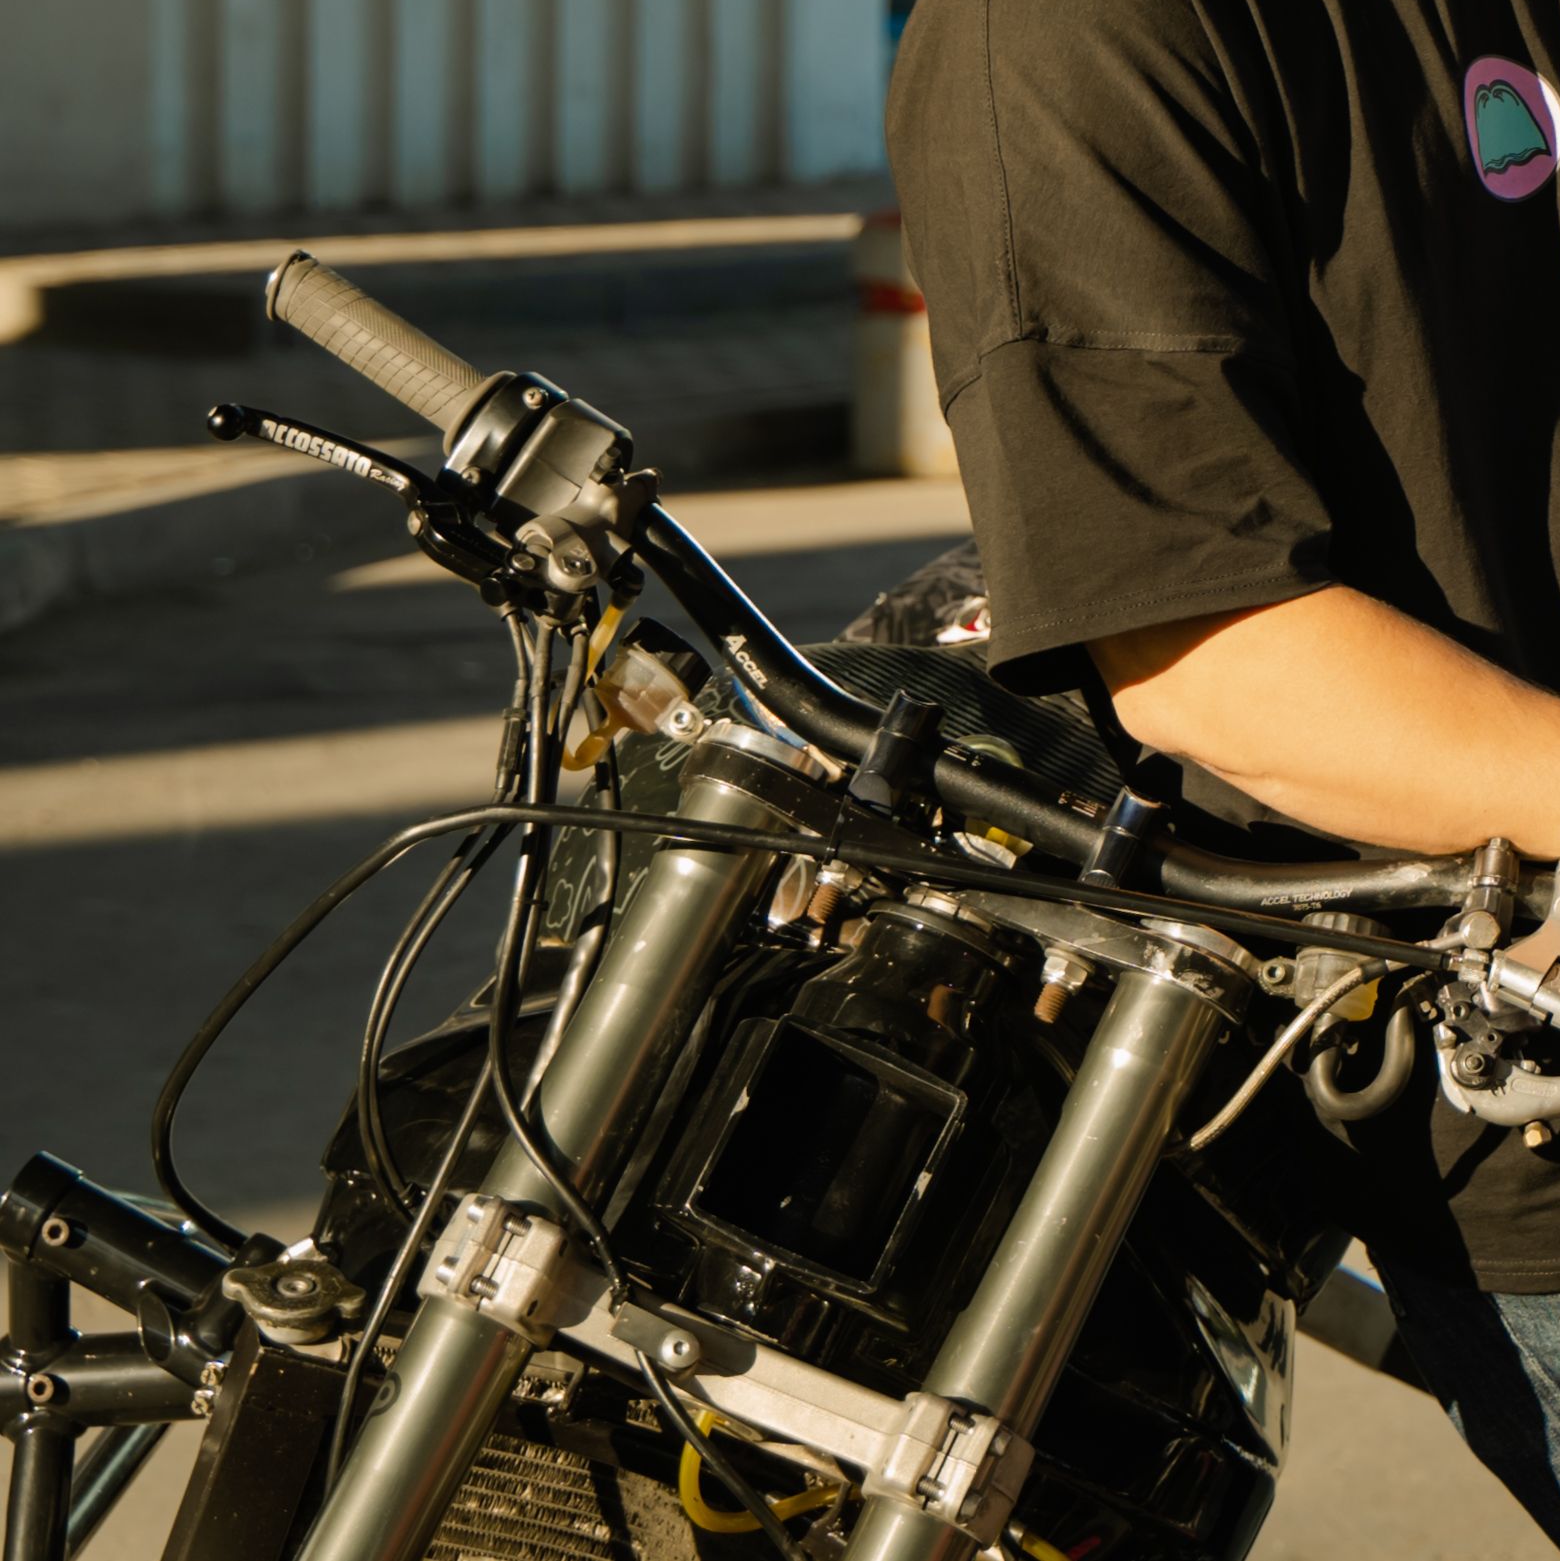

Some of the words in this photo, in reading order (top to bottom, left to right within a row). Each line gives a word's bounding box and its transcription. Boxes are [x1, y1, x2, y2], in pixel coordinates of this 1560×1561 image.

[259, 418, 373, 479] ACCOSSATO
[1261, 896, 1291, 906] ACCEL
[1293, 887, 1353, 903] TECHNOLOGY
